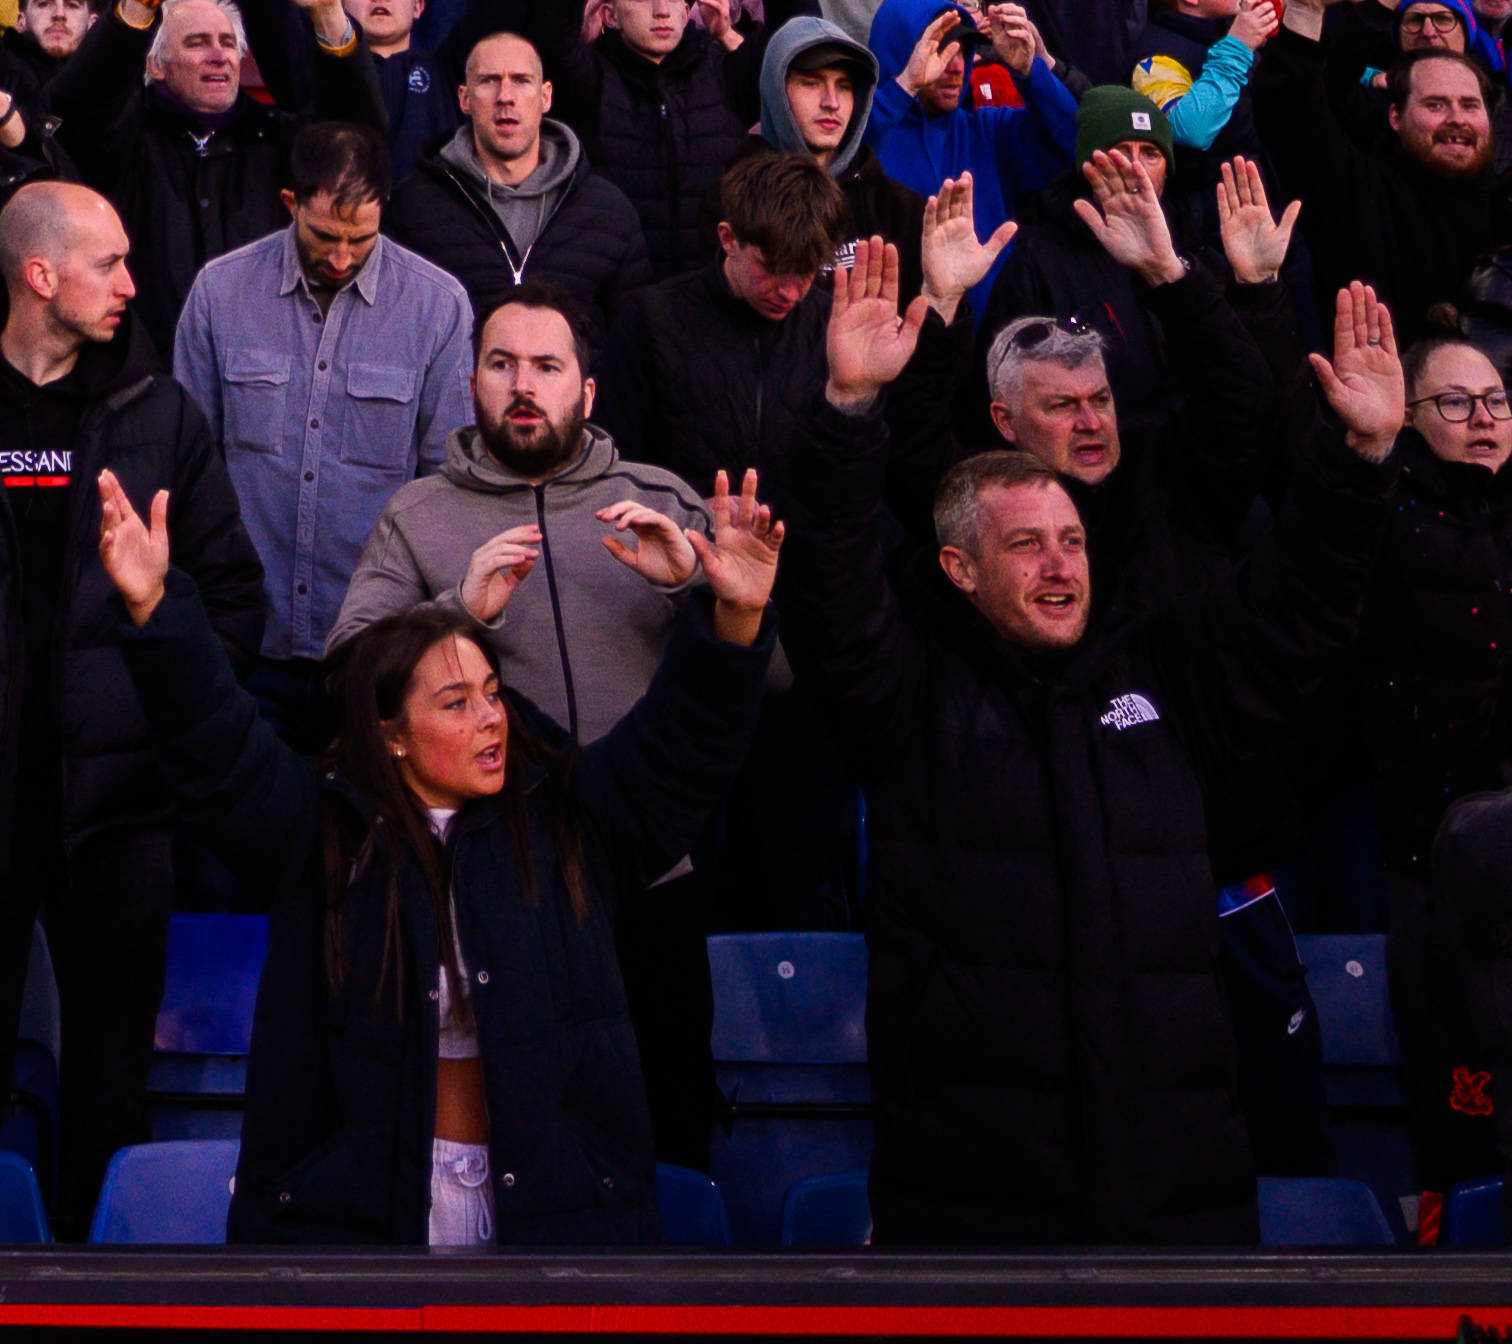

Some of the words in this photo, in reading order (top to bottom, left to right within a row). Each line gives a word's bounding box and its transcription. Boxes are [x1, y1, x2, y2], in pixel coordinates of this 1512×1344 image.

[1109, 694, 1132, 710] THE
[1100, 700, 1138, 726] NORTH
[1115, 713, 1144, 731] FACE
